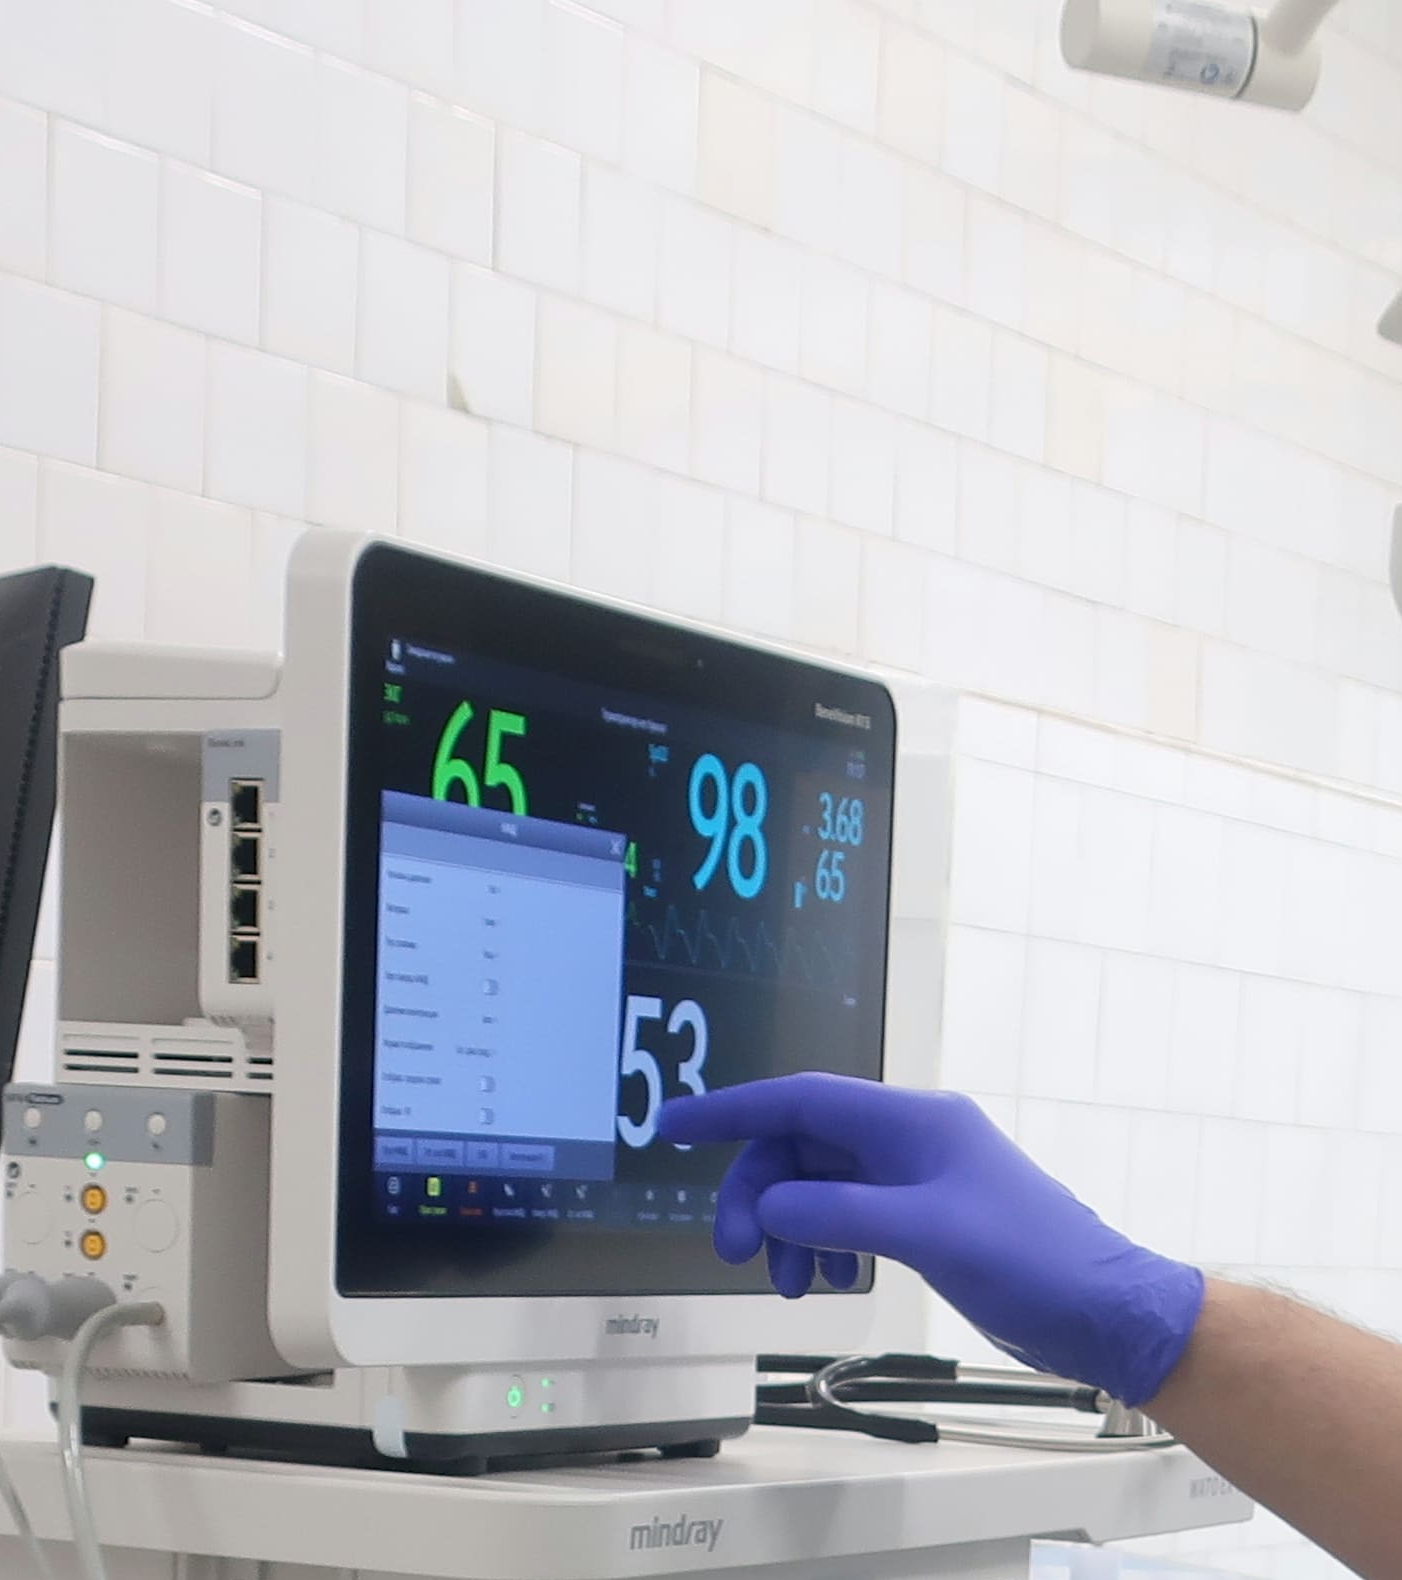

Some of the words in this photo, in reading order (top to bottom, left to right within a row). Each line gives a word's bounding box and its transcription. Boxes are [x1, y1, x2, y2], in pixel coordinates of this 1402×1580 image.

[431, 700, 528, 816] 65
[688, 752, 768, 899] 98
[817, 791, 865, 847] 3.68
[815, 849, 845, 902] 65
[616, 994, 708, 1149] 53
[605, 1313, 660, 1339] mindray
[629, 1513, 724, 1553] mindray
